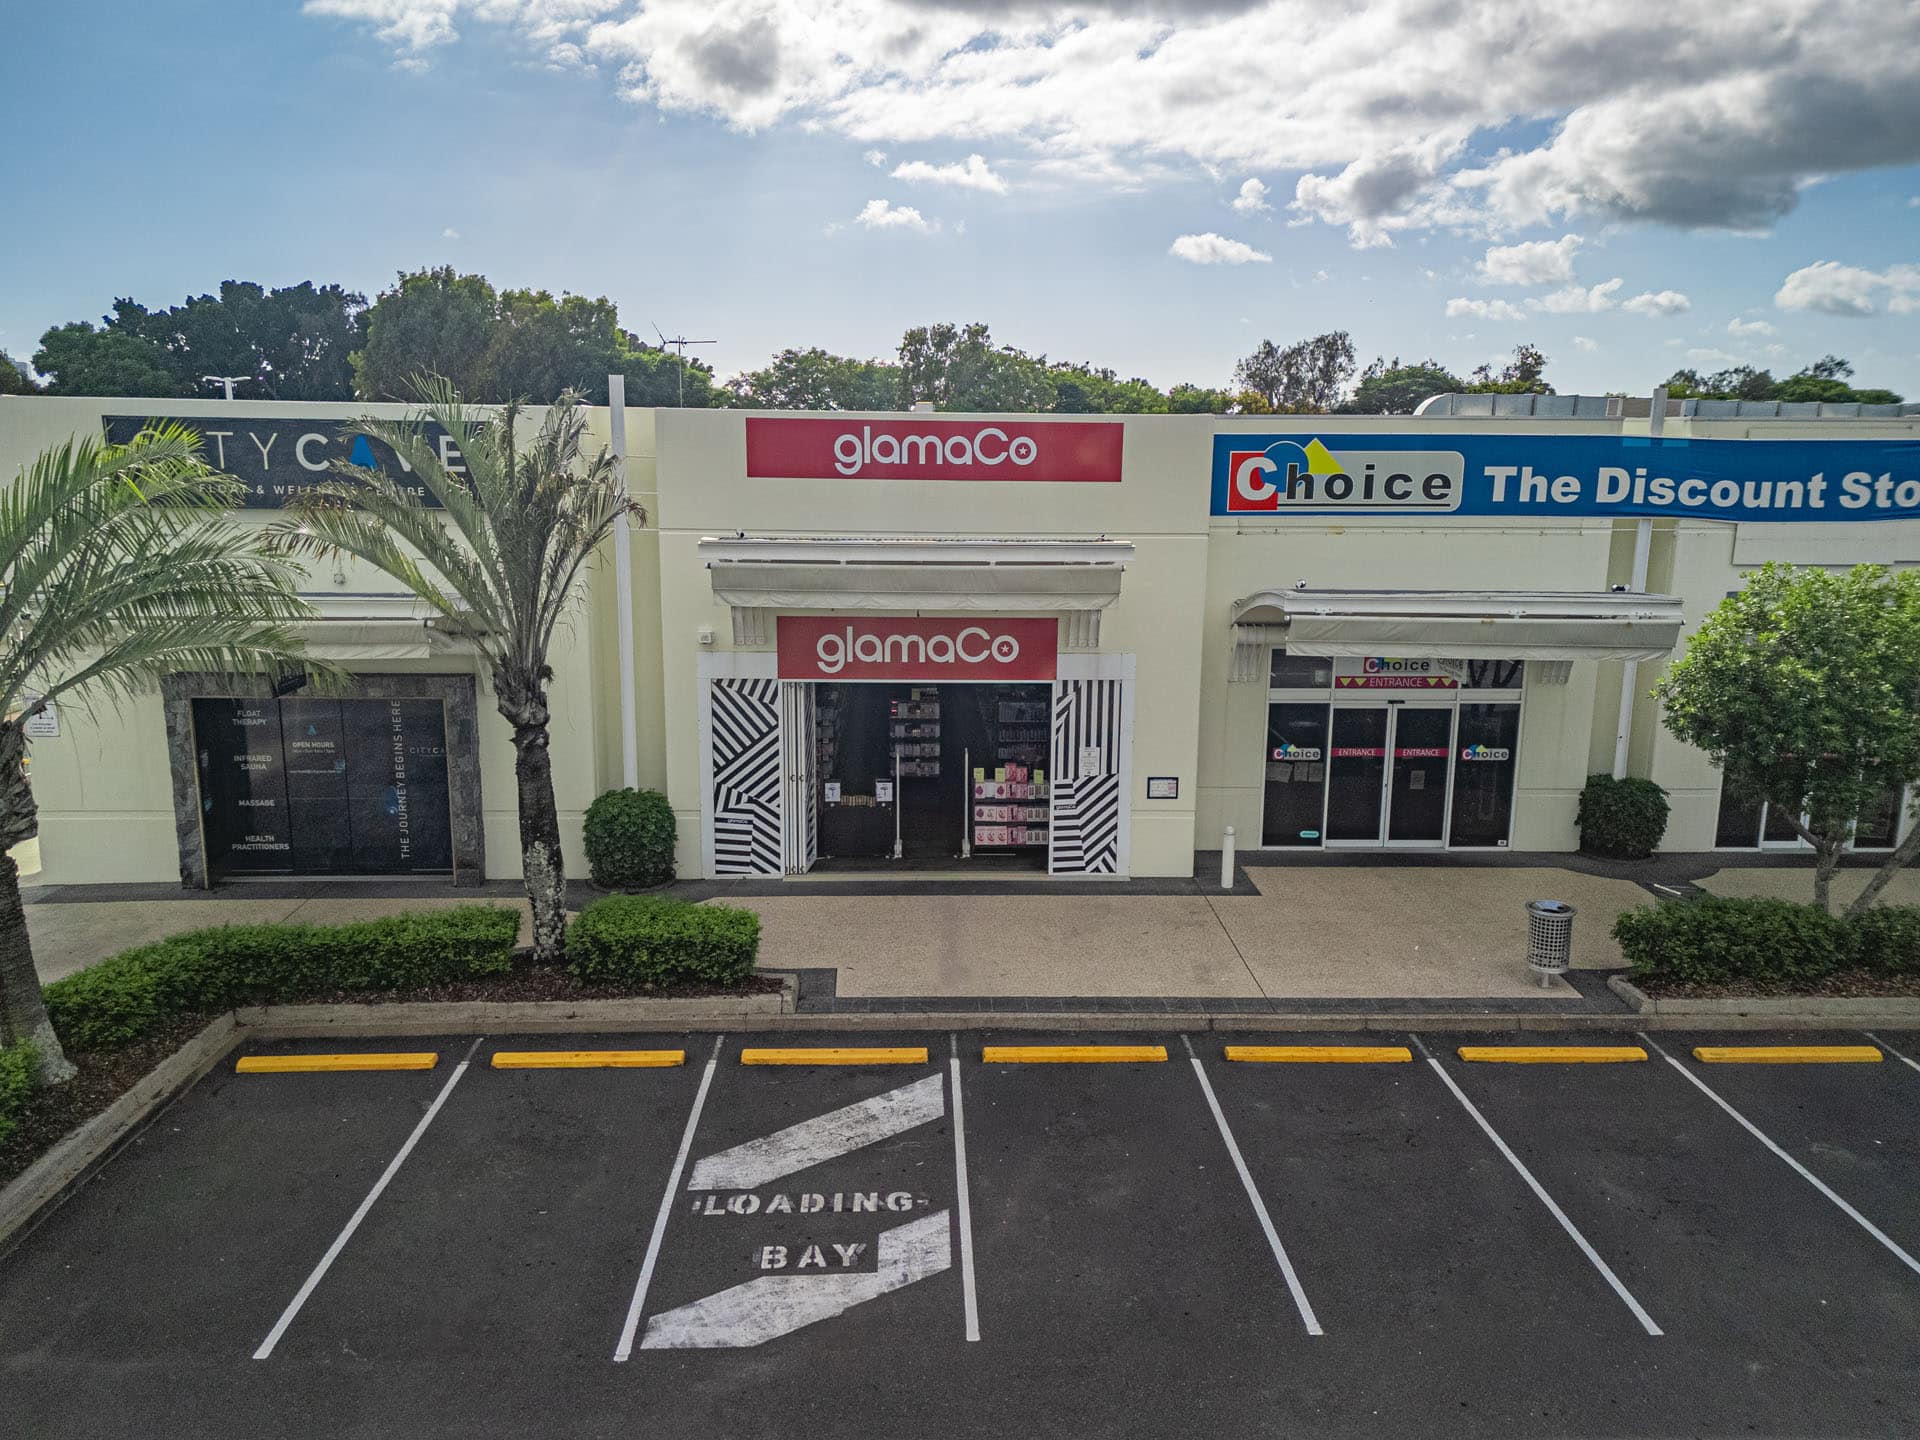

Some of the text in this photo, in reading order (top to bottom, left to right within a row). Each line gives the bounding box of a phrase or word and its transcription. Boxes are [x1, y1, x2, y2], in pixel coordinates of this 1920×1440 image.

[833, 425, 1038, 475] glamaCo
[256, 484, 265, 495] &
[1236, 455, 1451, 501] Choice
[1484, 465, 1582, 503] The
[1596, 467, 1827, 509] Discount
[816, 625, 1020, 674] glamaCo
[1365, 657, 1430, 673] Choice
[1369, 677, 1424, 688] ENTRANCE
[1274, 748, 1320, 760] Choice
[1338, 748, 1377, 757] ENTRANCE
[1402, 748, 1441, 757] ENTRANCE
[1462, 748, 1508, 760] Choice
[391, 700, 411, 859] THE JOURNEY BEGINS HERE
[702, 1191, 914, 1215] LOADING
[760, 1243, 863, 1270] BAY
